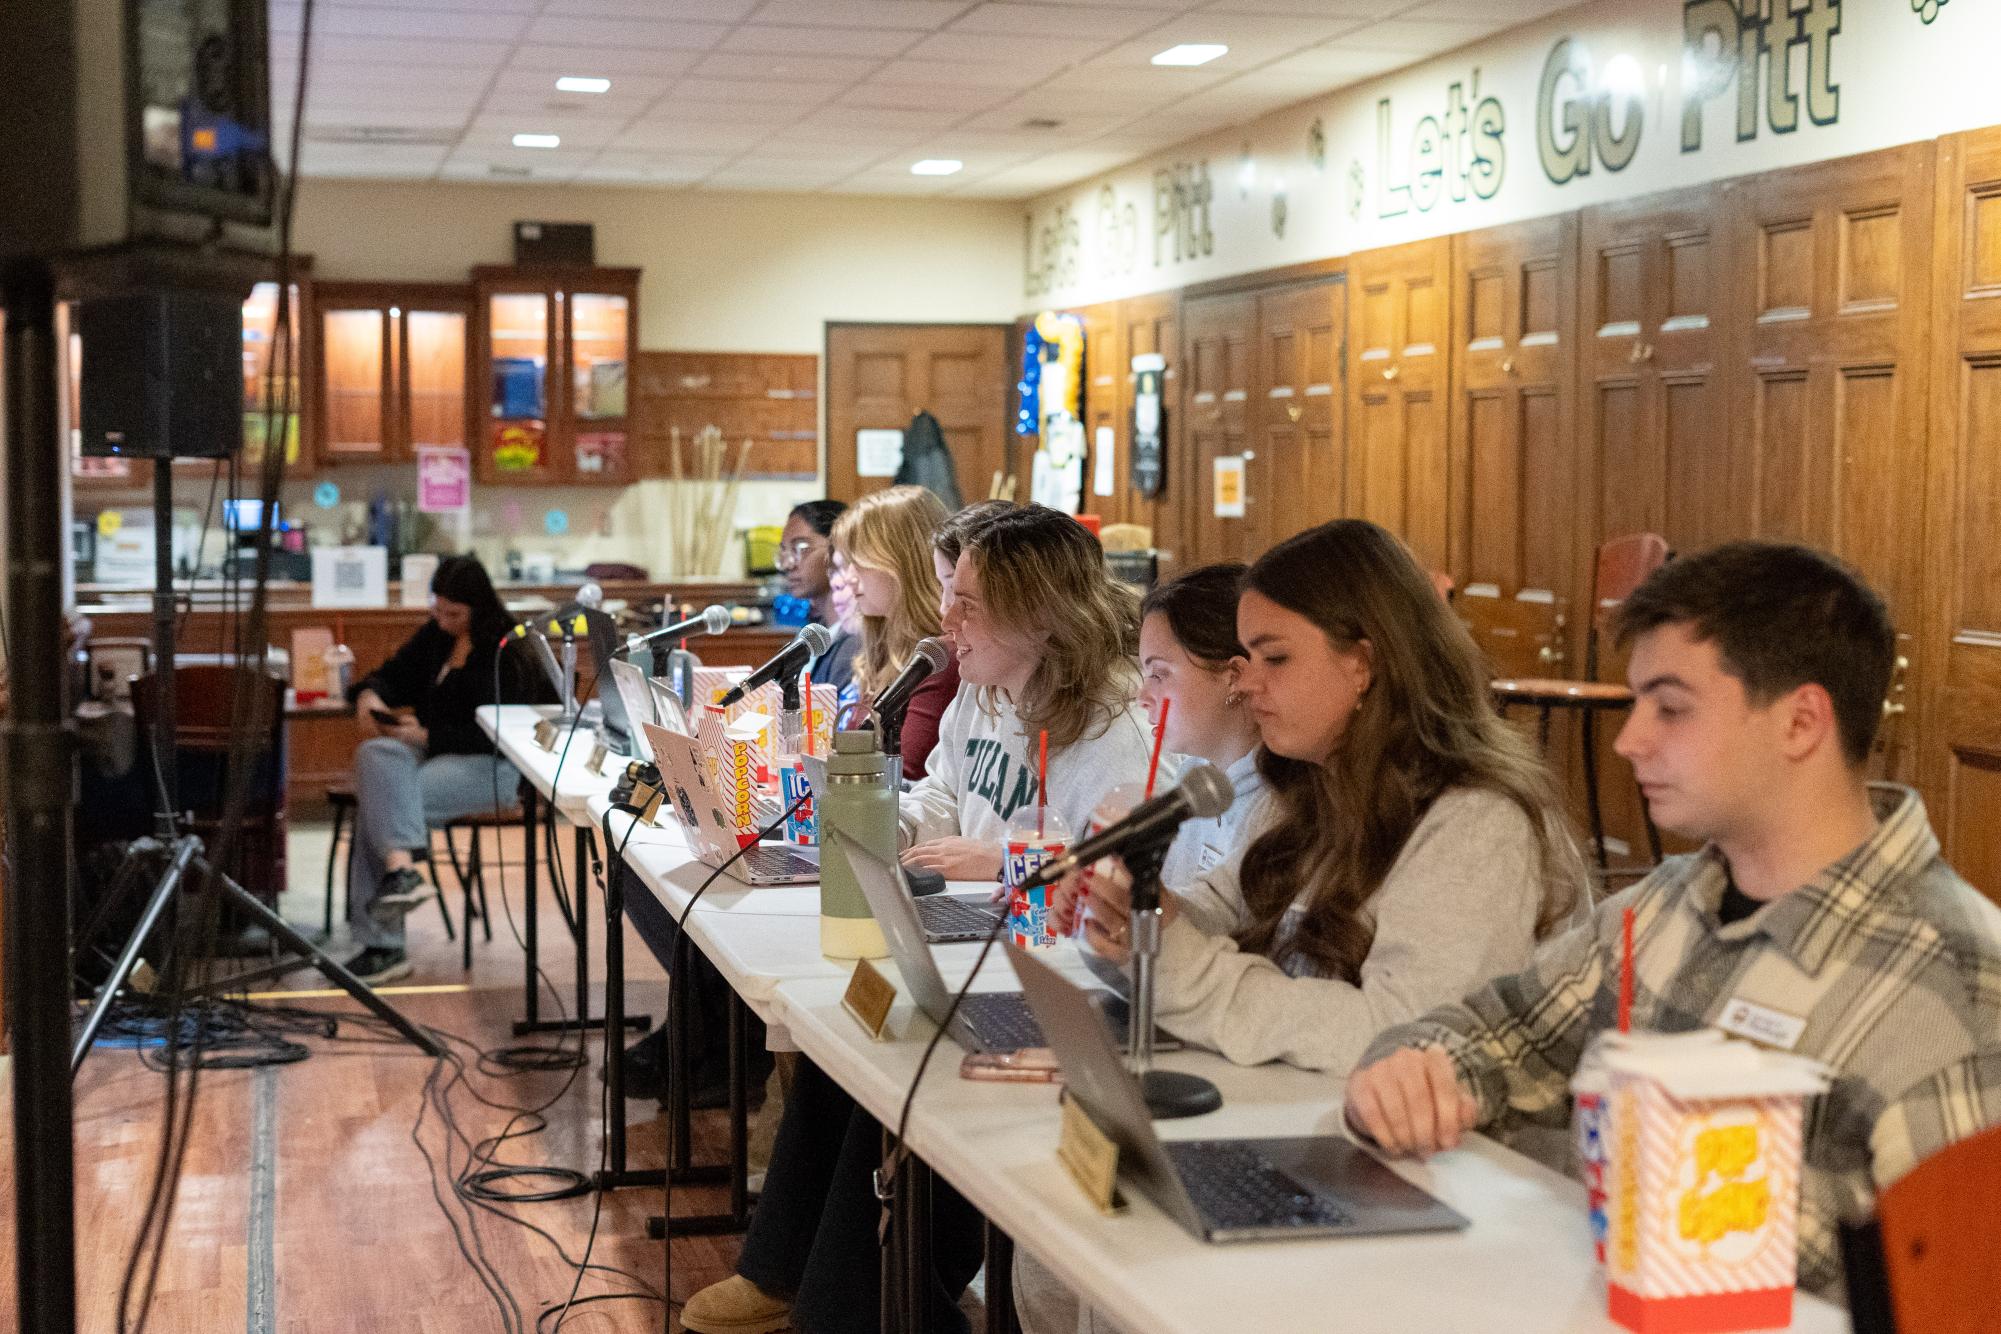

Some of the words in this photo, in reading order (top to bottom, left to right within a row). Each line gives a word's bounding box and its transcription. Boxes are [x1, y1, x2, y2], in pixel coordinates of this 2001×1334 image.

[1376, 67, 1505, 219] Let's
[1535, 35, 1644, 186] Go
[1680, 0, 1842, 155] Pitt
[1152, 160, 1214, 268] Pitt
[732, 741, 753, 829] POPCORN
[966, 738, 1043, 822] TULAN
